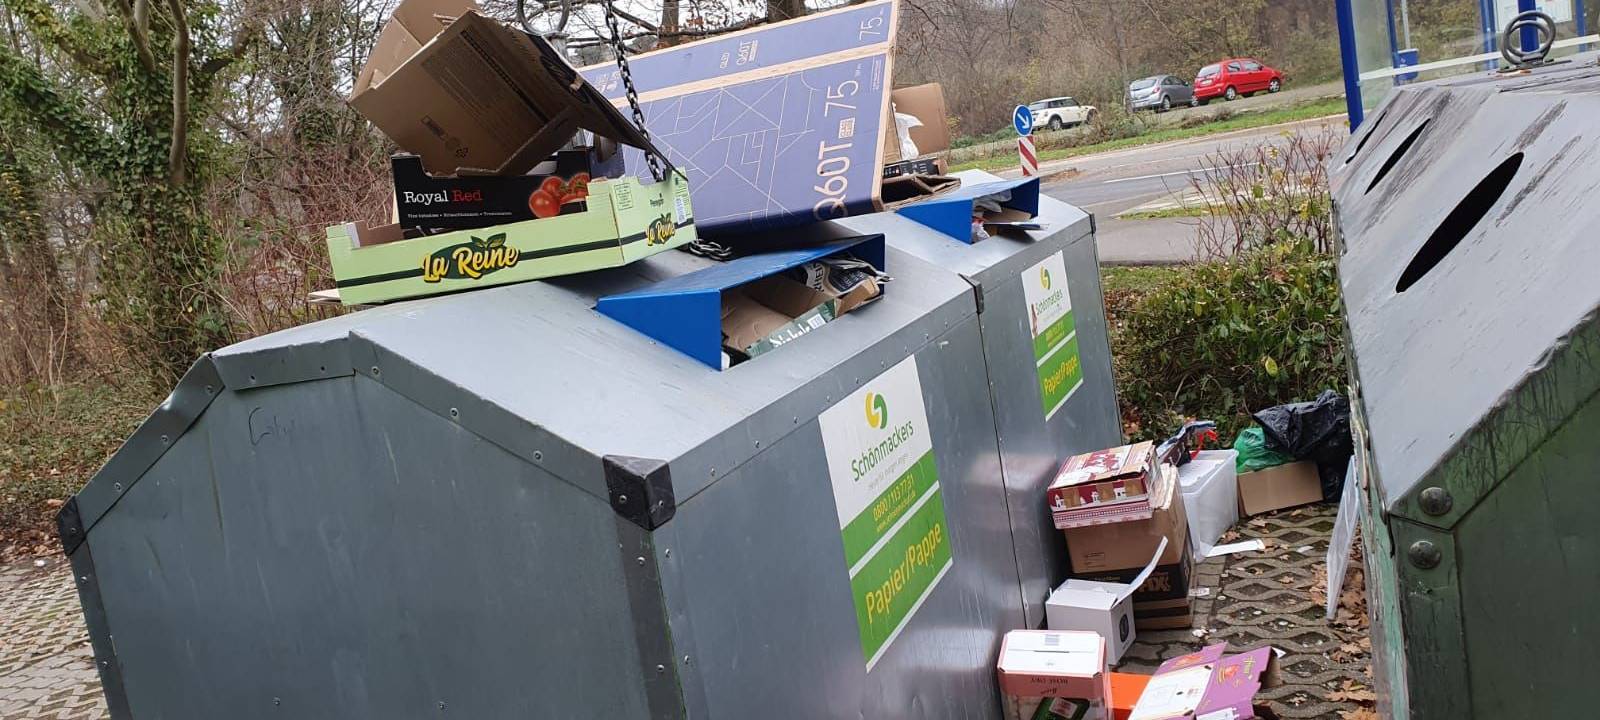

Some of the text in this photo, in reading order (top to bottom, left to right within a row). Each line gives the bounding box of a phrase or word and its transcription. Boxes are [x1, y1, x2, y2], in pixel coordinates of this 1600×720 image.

[860, 17, 882, 40] 75
[824, 80, 858, 117] 75
[403, 189, 482, 206] Royal Red
[813, 140, 853, 221] Q60T
[423, 246, 519, 283] La Reine
[851, 419, 914, 482] Schönmackers
[865, 521, 942, 624] Papier/Pappe
